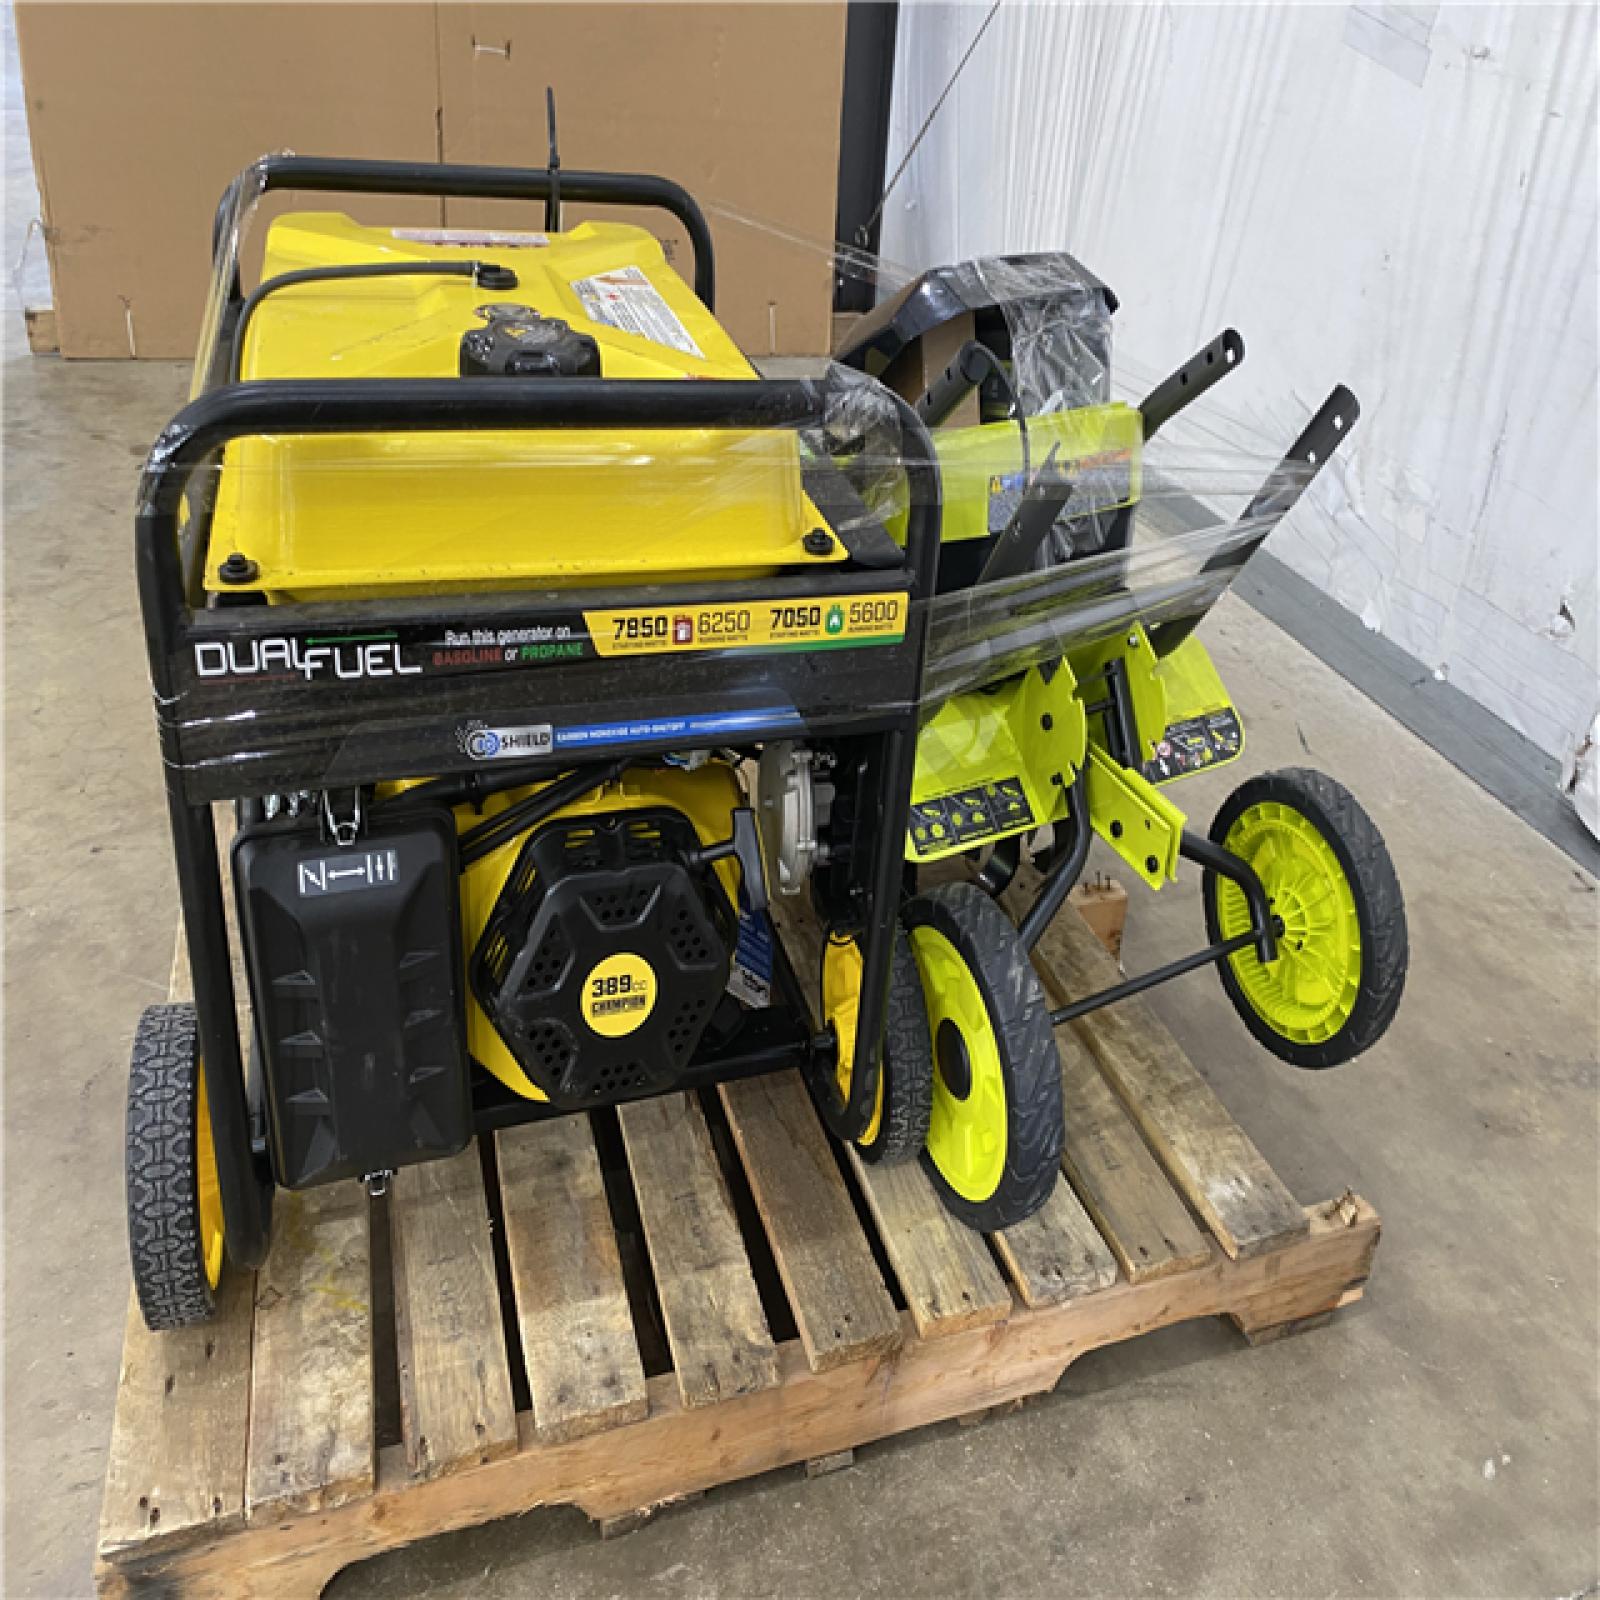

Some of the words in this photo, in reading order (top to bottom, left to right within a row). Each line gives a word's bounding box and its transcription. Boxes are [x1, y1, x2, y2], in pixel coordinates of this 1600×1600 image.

[697, 609, 751, 635] 6250
[769, 604, 821, 631] 7050
[849, 599, 899, 624] 5600
[445, 630, 470, 646] Run
[472, 628, 495, 644] this
[497, 626, 554, 646] generator
[555, 626, 570, 640] on
[612, 615, 668, 641] 7850
[432, 646, 502, 666] GASOLINE
[504, 648, 518, 661] or
[520, 642, 583, 660] PROPANE
[501, 731, 550, 750] SHIELD
[591, 995, 646, 1013] CHAMPION
